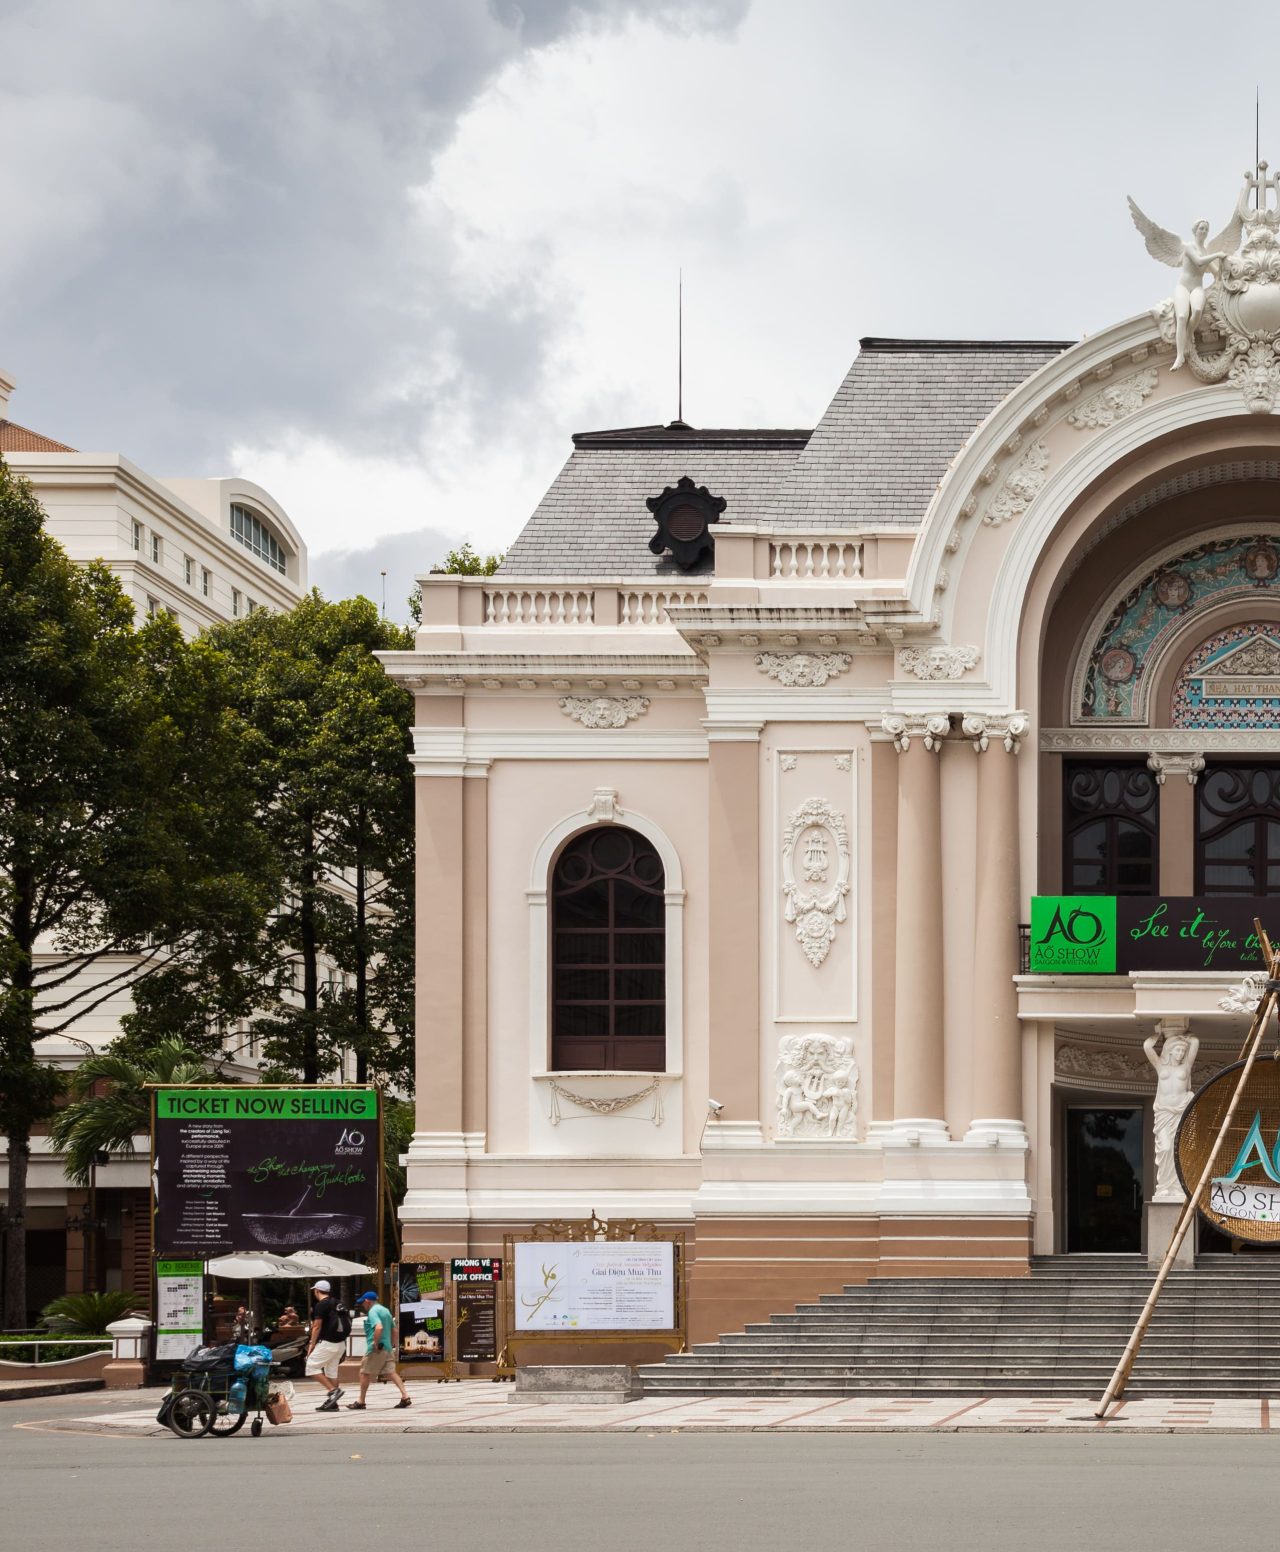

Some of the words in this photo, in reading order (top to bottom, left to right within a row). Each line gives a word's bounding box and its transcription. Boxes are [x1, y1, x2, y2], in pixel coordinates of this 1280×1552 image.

[1130, 904, 1169, 940] See
[1179, 907, 1219, 938] it
[1058, 948, 1100, 960] SHOW
[1202, 930, 1237, 966] before
[168, 1098, 229, 1114] TICKET
[236, 1098, 282, 1114] NOW
[290, 1097, 366, 1115] SELLING
[1211, 1202, 1257, 1220] SAIGON
